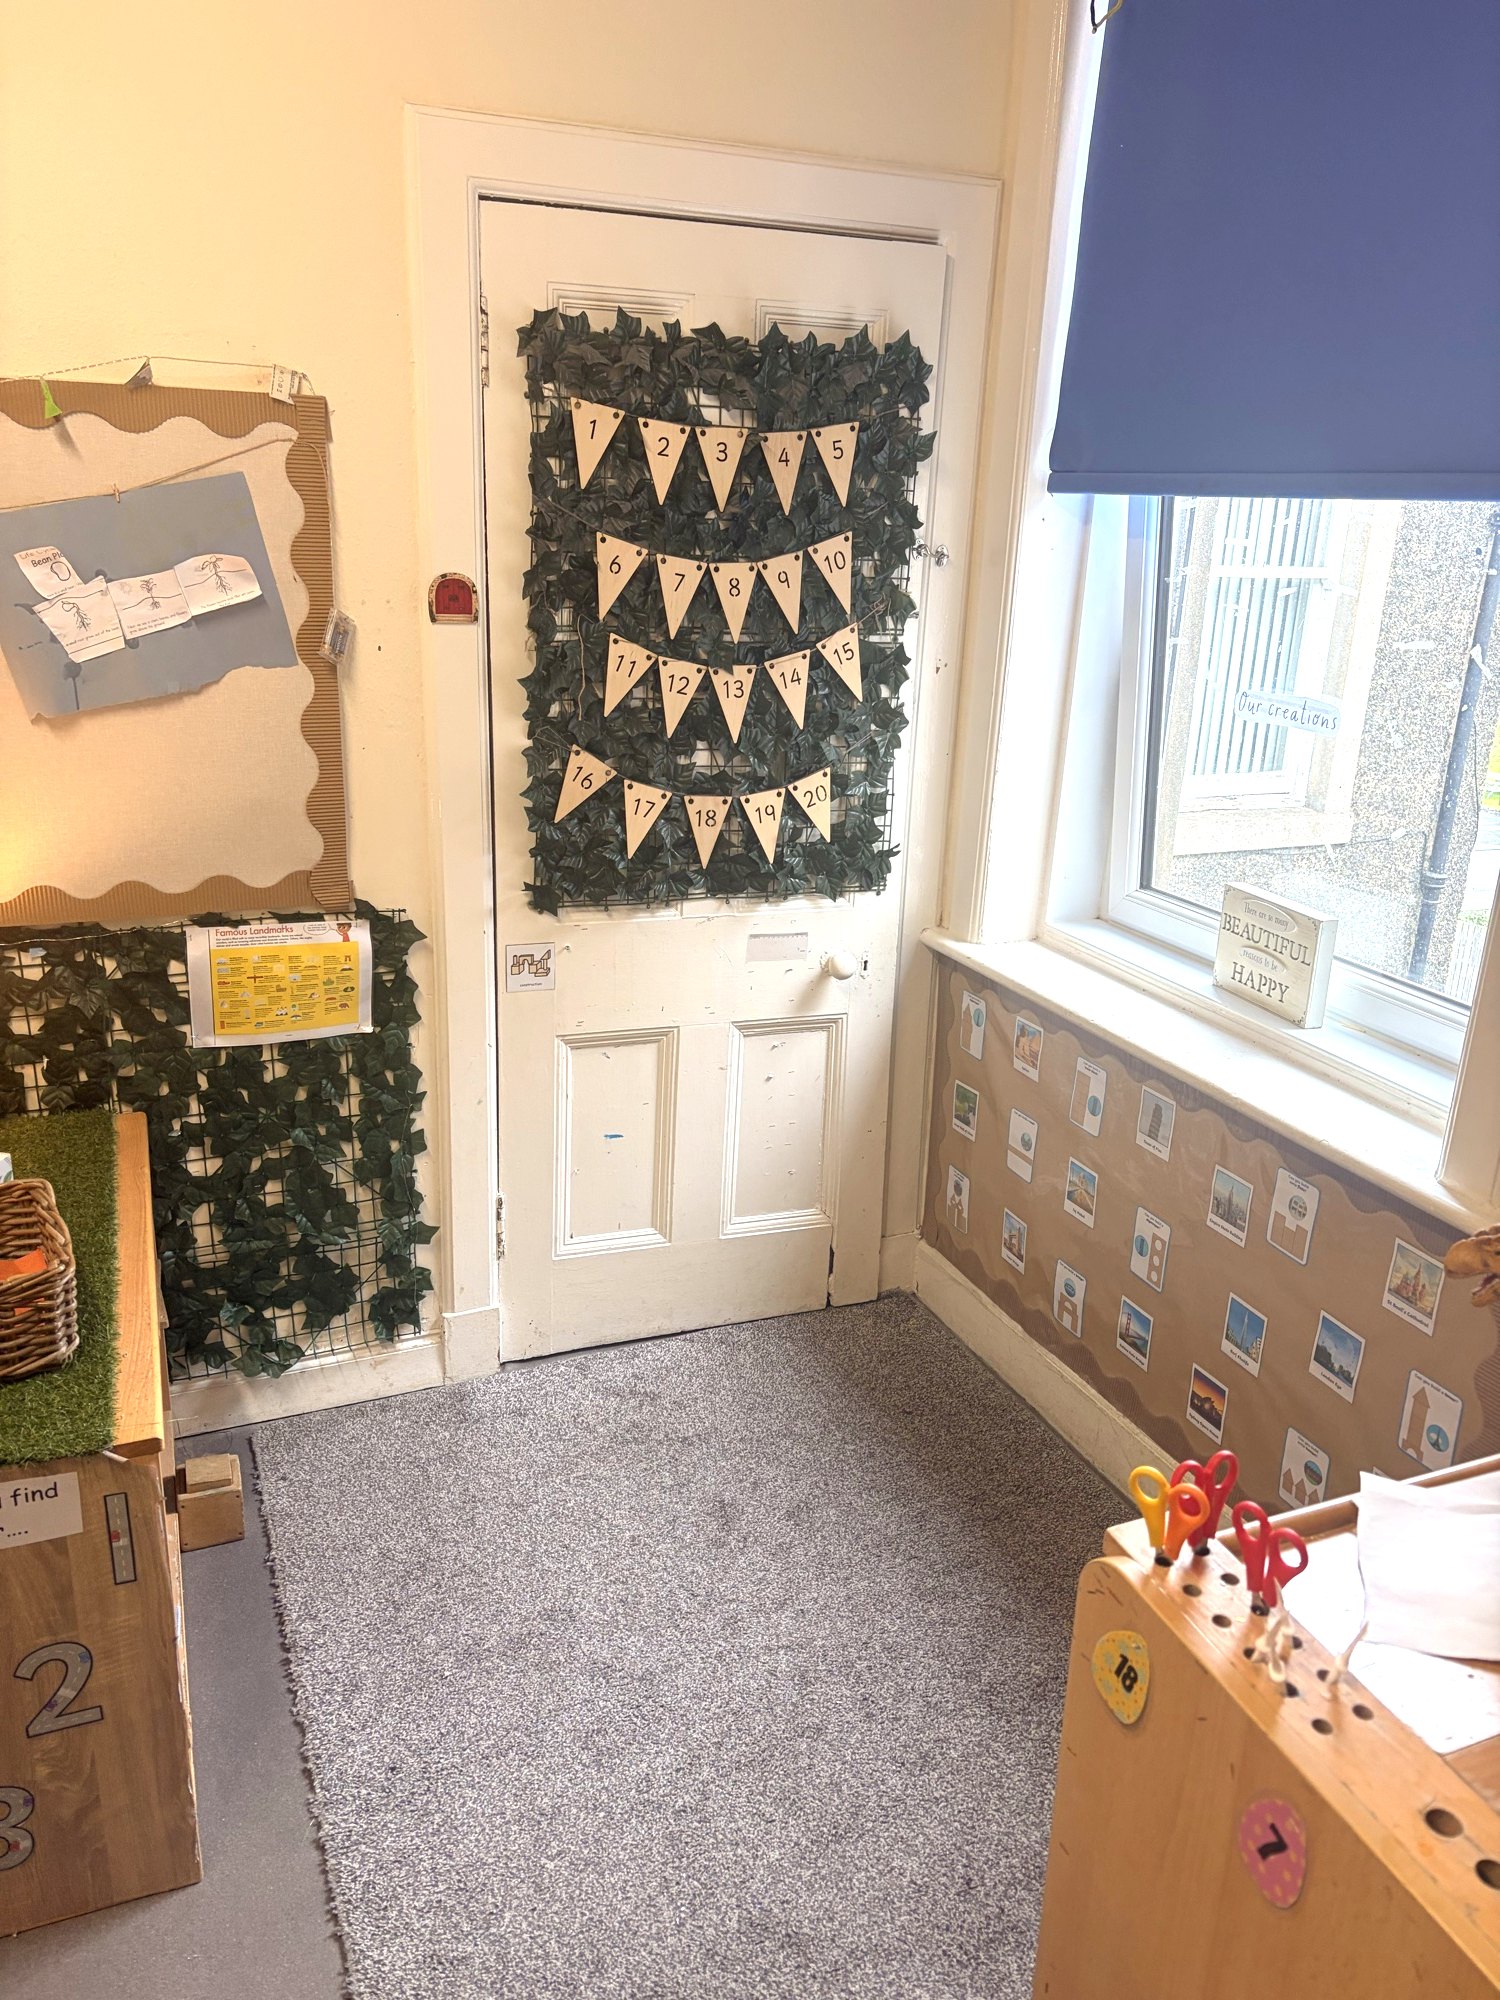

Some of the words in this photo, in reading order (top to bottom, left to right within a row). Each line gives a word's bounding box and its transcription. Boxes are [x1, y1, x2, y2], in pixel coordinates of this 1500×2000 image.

[589, 419, 597, 440] 1
[657, 436, 670, 458] 2
[716, 441, 728, 463] 3
[778, 447, 790, 467] 4
[832, 439, 844, 460] 5
[31, 556, 52, 567] Bean
[609, 555, 622, 575] 6
[824, 550, 846, 574] 10
[674, 572, 686, 592] 7
[729, 577, 741, 597] 8
[777, 570, 790, 589] 9
[833, 641, 854, 665] 15
[615, 654, 637, 678] 11
[668, 674, 690, 696] 12
[723, 679, 744, 699] 13
[779, 668, 802, 689] 14
[1238, 691, 1262, 715] Our
[1268, 700, 1338, 730] creations
[572, 766, 594, 790] 16
[803, 785, 827, 808] 20
[634, 798, 656, 818] 17
[695, 809, 717, 827] 18
[755, 804, 776, 824] 19
[1244, 902, 1258, 916] There
[1258, 911, 1268, 919] are
[1274, 917, 1289, 931] many
[215, 928, 248, 937] Famous
[249, 925, 294, 936] Landmarks
[1222, 912, 1311, 967] BEAUTIFUL
[1242, 949, 1263, 964] reasons
[1271, 960, 1278, 972] be
[1231, 961, 1290, 1004] HAPPY
[10, 1481, 59, 1507] find
[1114, 1653, 1139, 1693] 18
[13, 1640, 105, 1739] 2
[1257, 1823, 1289, 1861] 7
